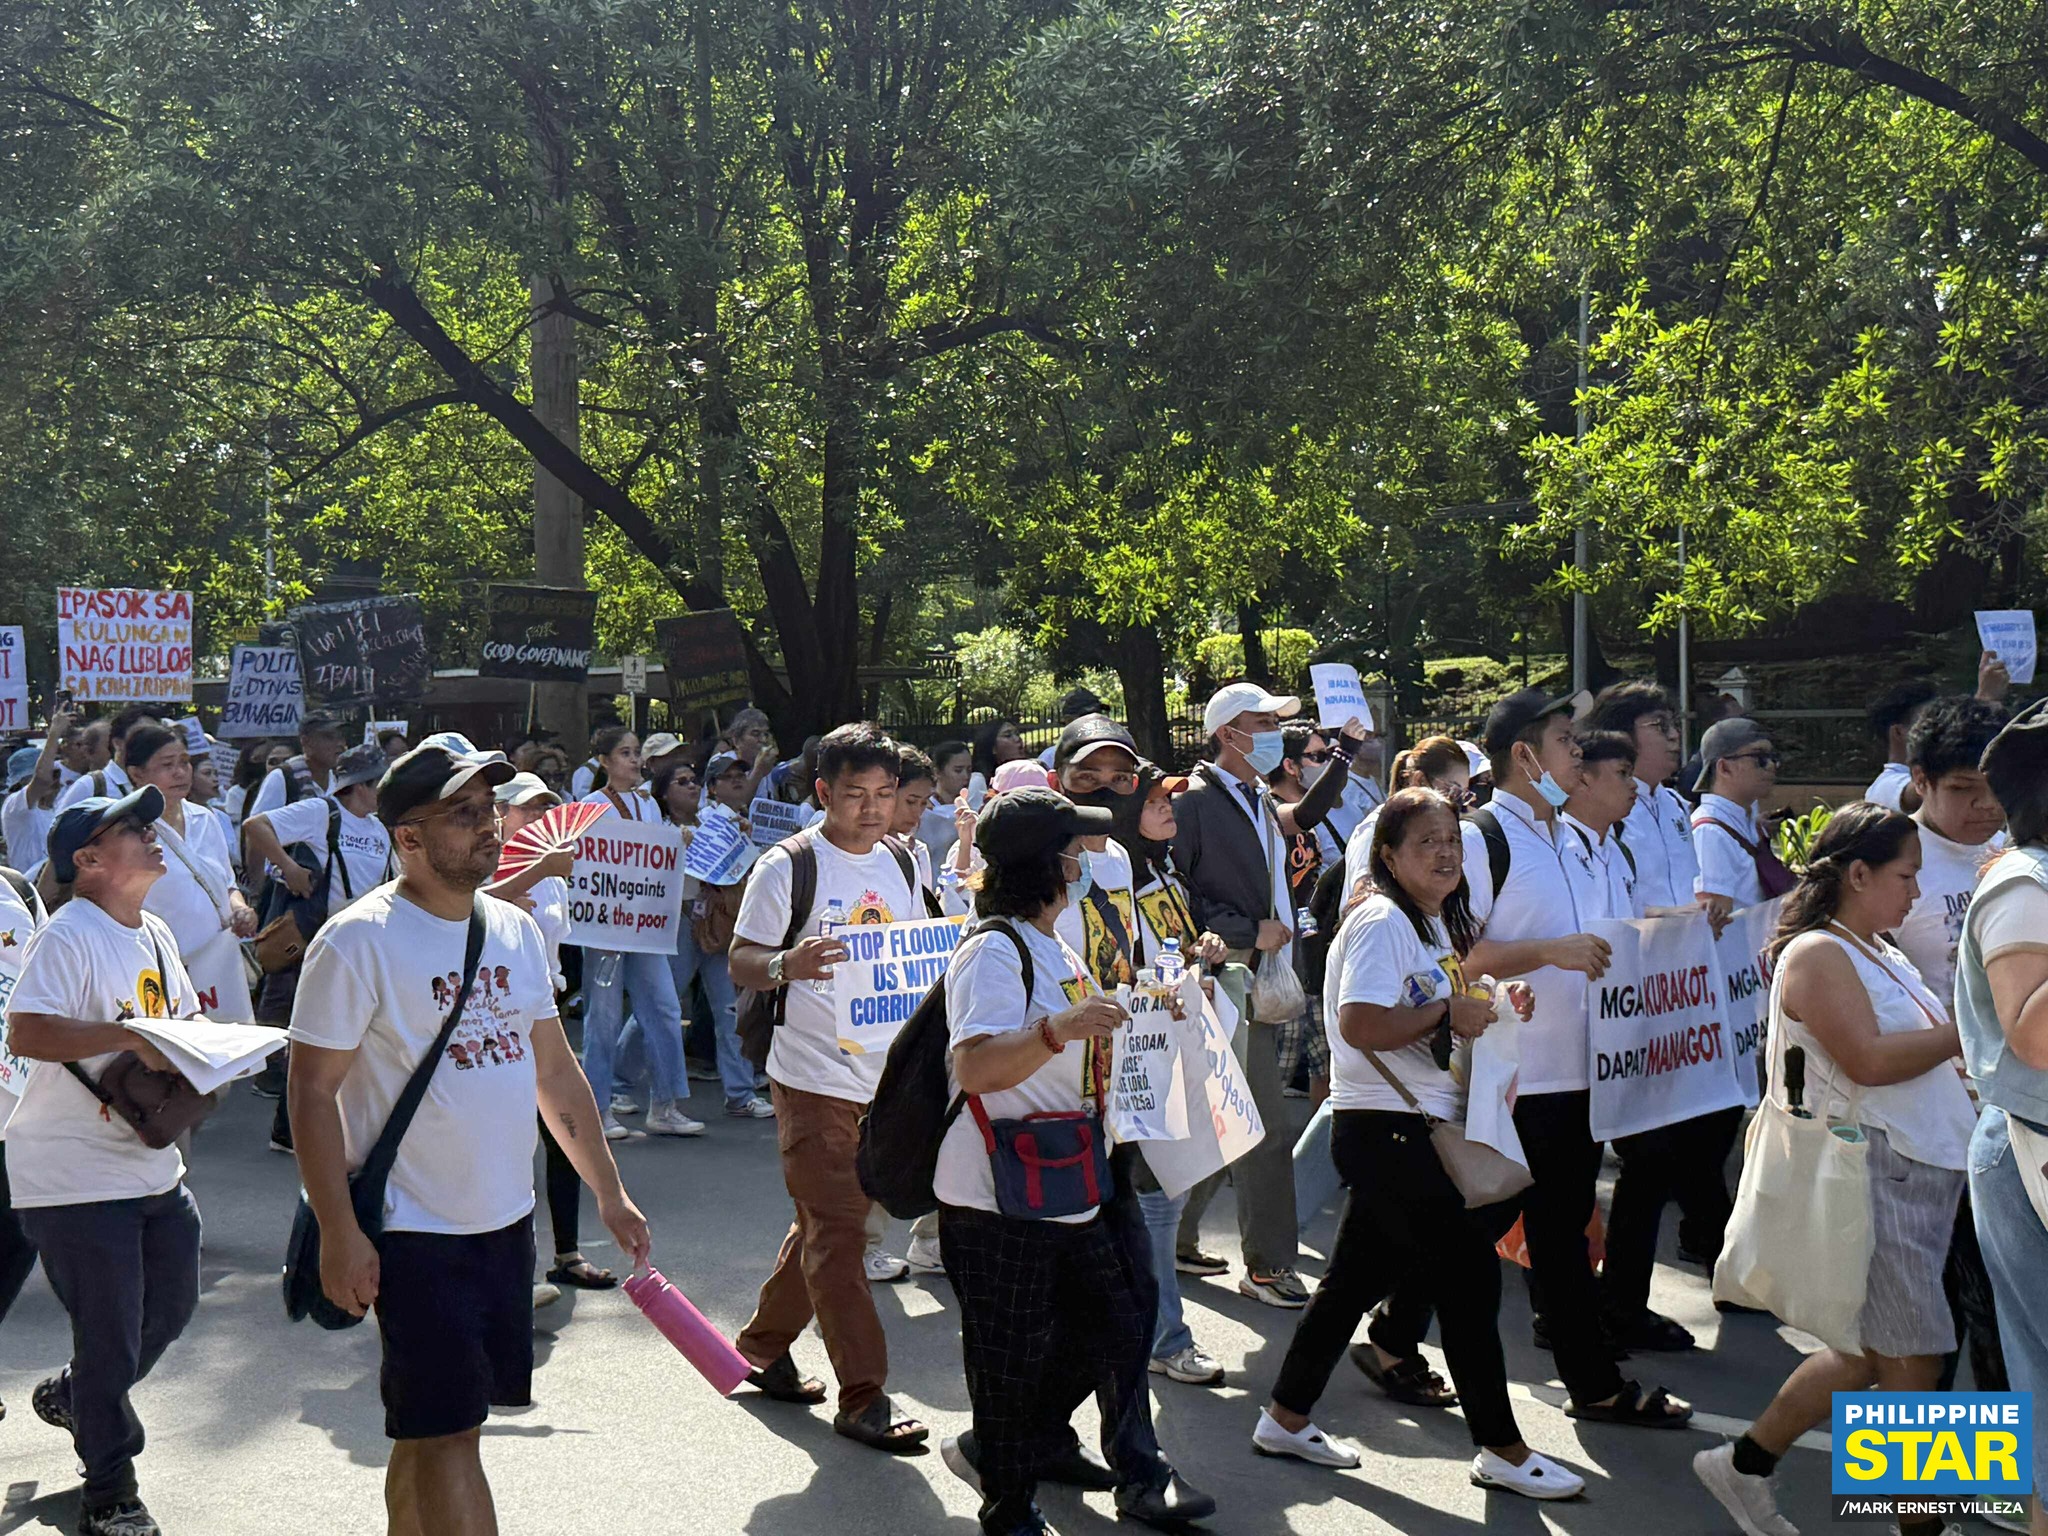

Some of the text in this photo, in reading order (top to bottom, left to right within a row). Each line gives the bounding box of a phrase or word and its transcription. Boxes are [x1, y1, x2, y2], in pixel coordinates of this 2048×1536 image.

[59, 591, 190, 620] IPASOK SA
[74, 621, 187, 643] KULUNGAN
[574, 837, 678, 871] ORRUPTION
[579, 876, 588, 889] a
[591, 871, 618, 898] SIN
[618, 877, 666, 901] againts
[598, 903, 609, 924] &
[613, 903, 634, 926] the
[636, 913, 668, 933] poor
[838, 931, 884, 961] STOP
[873, 962, 899, 992] US
[1129, 1033, 1168, 1053] GROAN,
